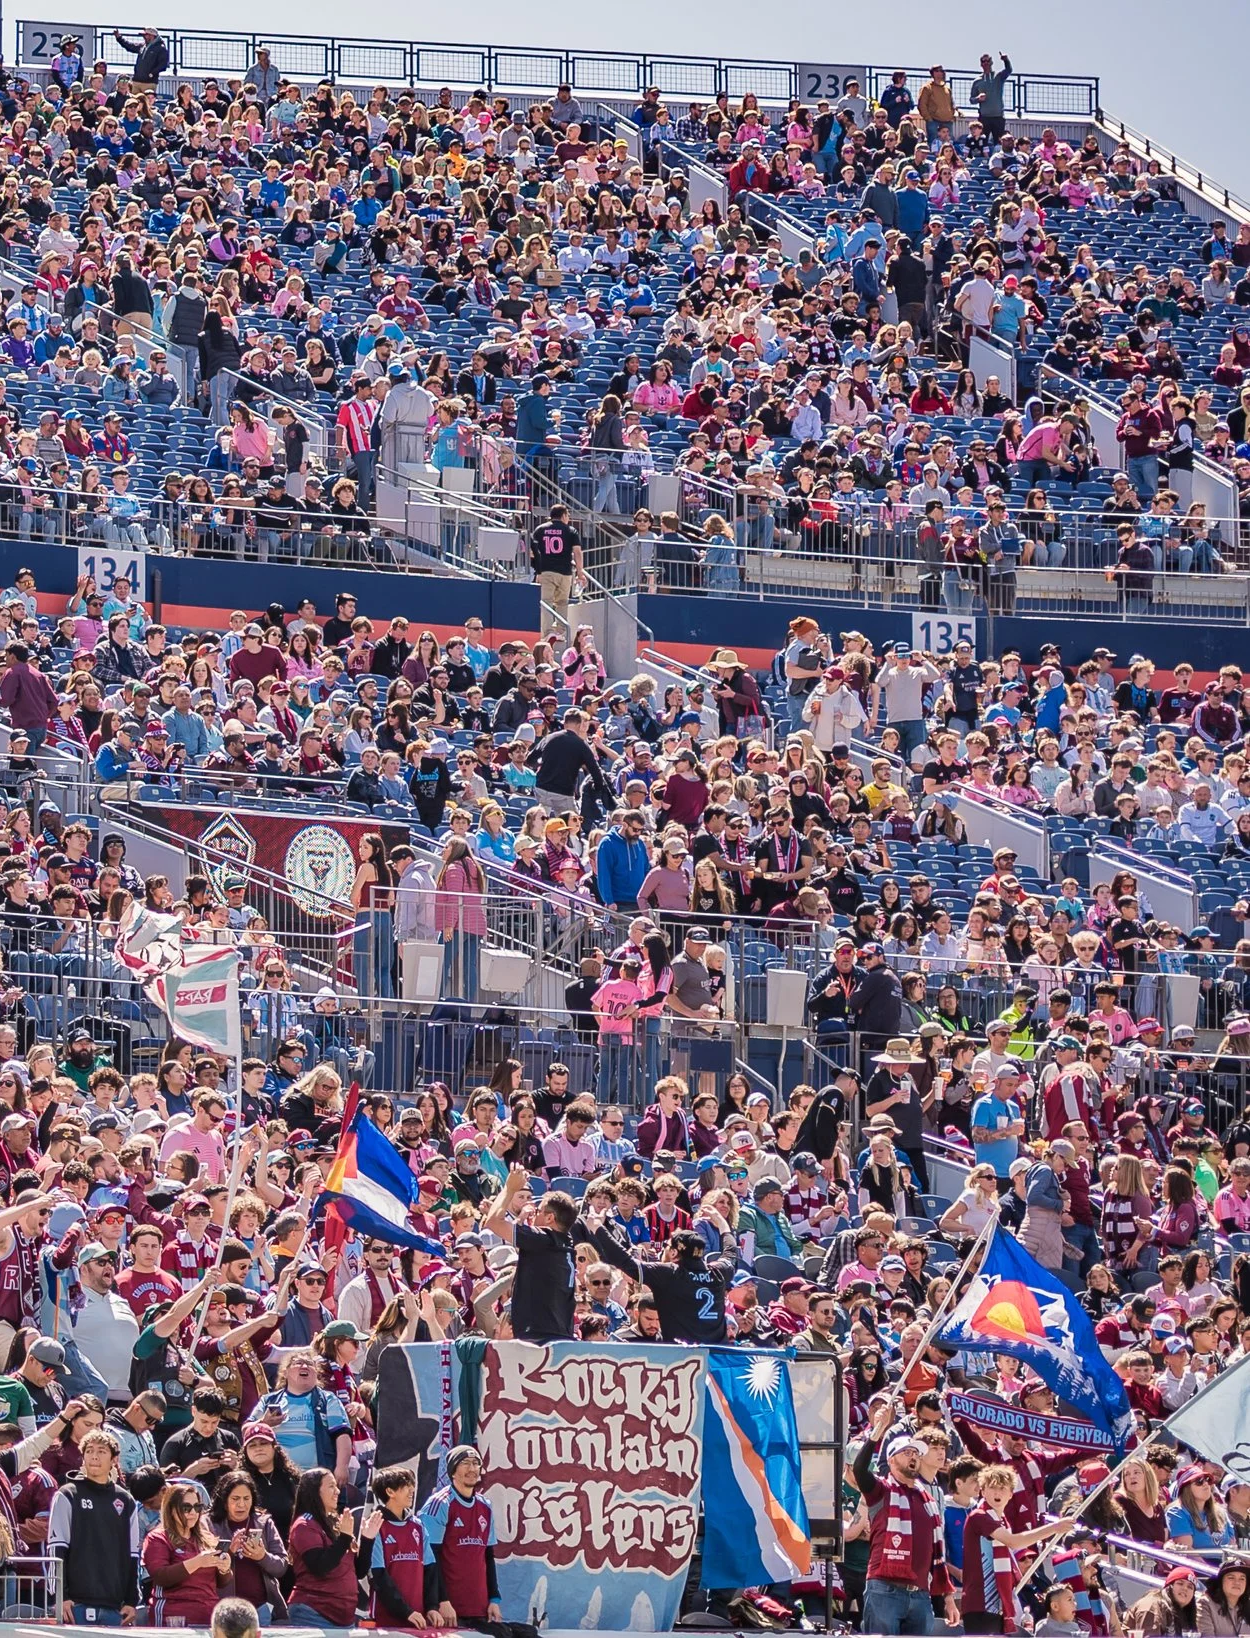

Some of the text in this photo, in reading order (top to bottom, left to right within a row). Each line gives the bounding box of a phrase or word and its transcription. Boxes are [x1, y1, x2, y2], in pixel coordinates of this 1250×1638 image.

[543, 536, 564, 555] 10
[84, 556, 141, 595] 134
[919, 621, 972, 655] 135
[607, 999, 627, 1021] 10
[611, 992, 628, 1000] MESSI
[696, 1287, 718, 1319] 2
[441, 1377, 452, 1450] RANK
[951, 1396, 1115, 1447] COLORADO VS EVERYBO
[81, 1498, 94, 1510] 63
